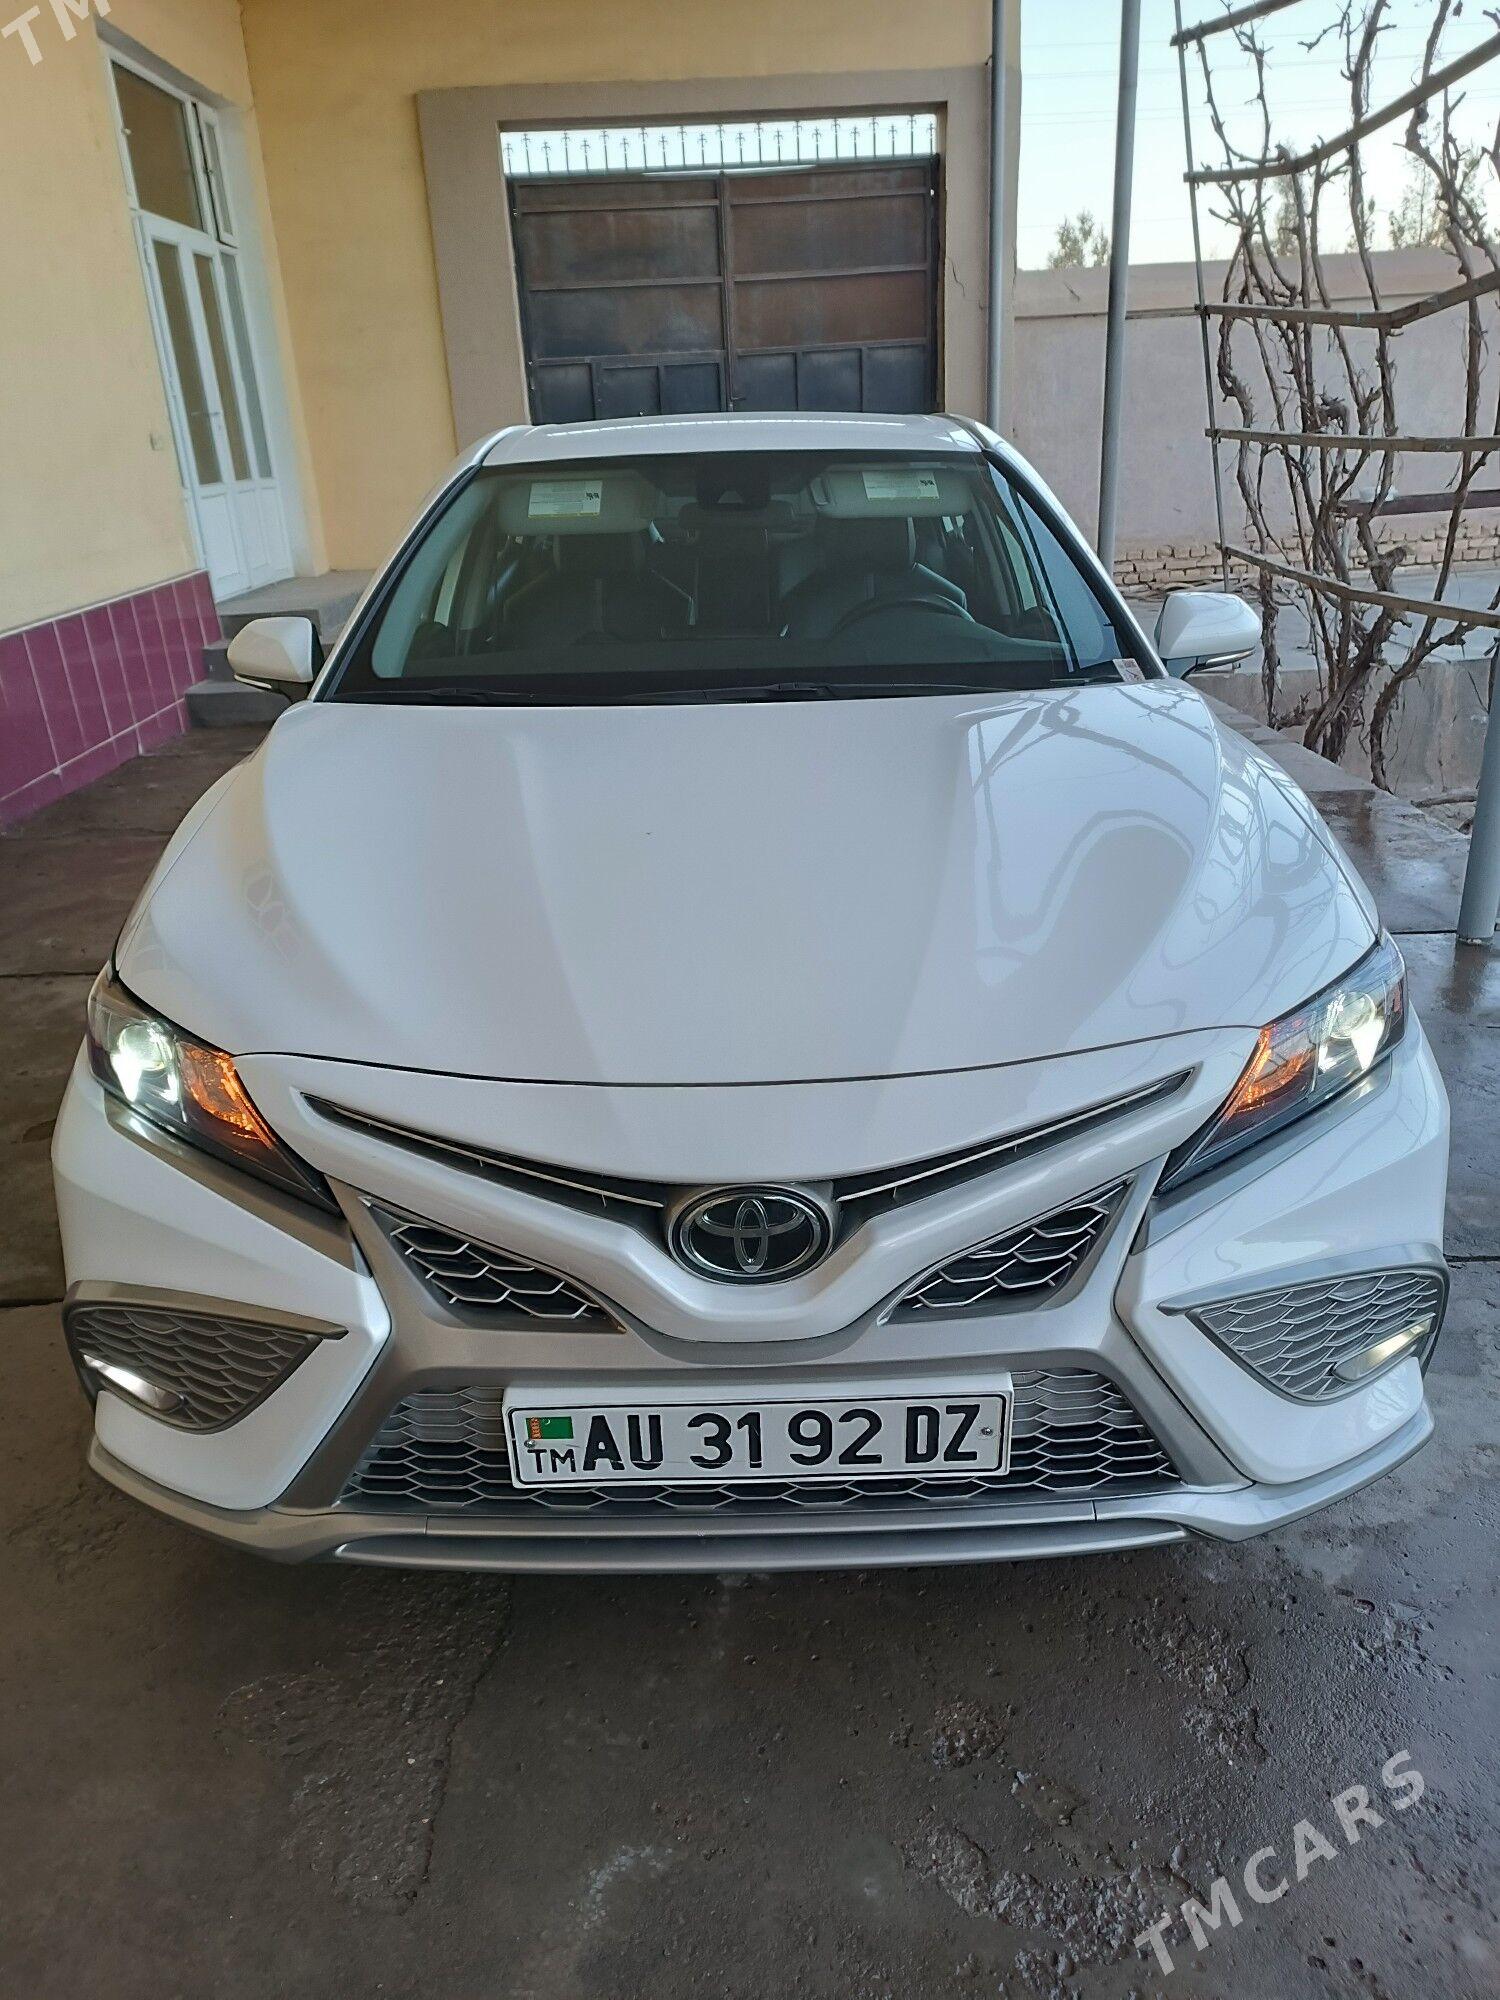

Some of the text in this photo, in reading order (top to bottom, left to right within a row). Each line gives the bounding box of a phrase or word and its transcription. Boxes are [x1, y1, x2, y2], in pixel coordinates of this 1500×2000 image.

[583, 1404, 981, 1471] AU 31 92 DZ
[527, 1448, 577, 1474] TM
